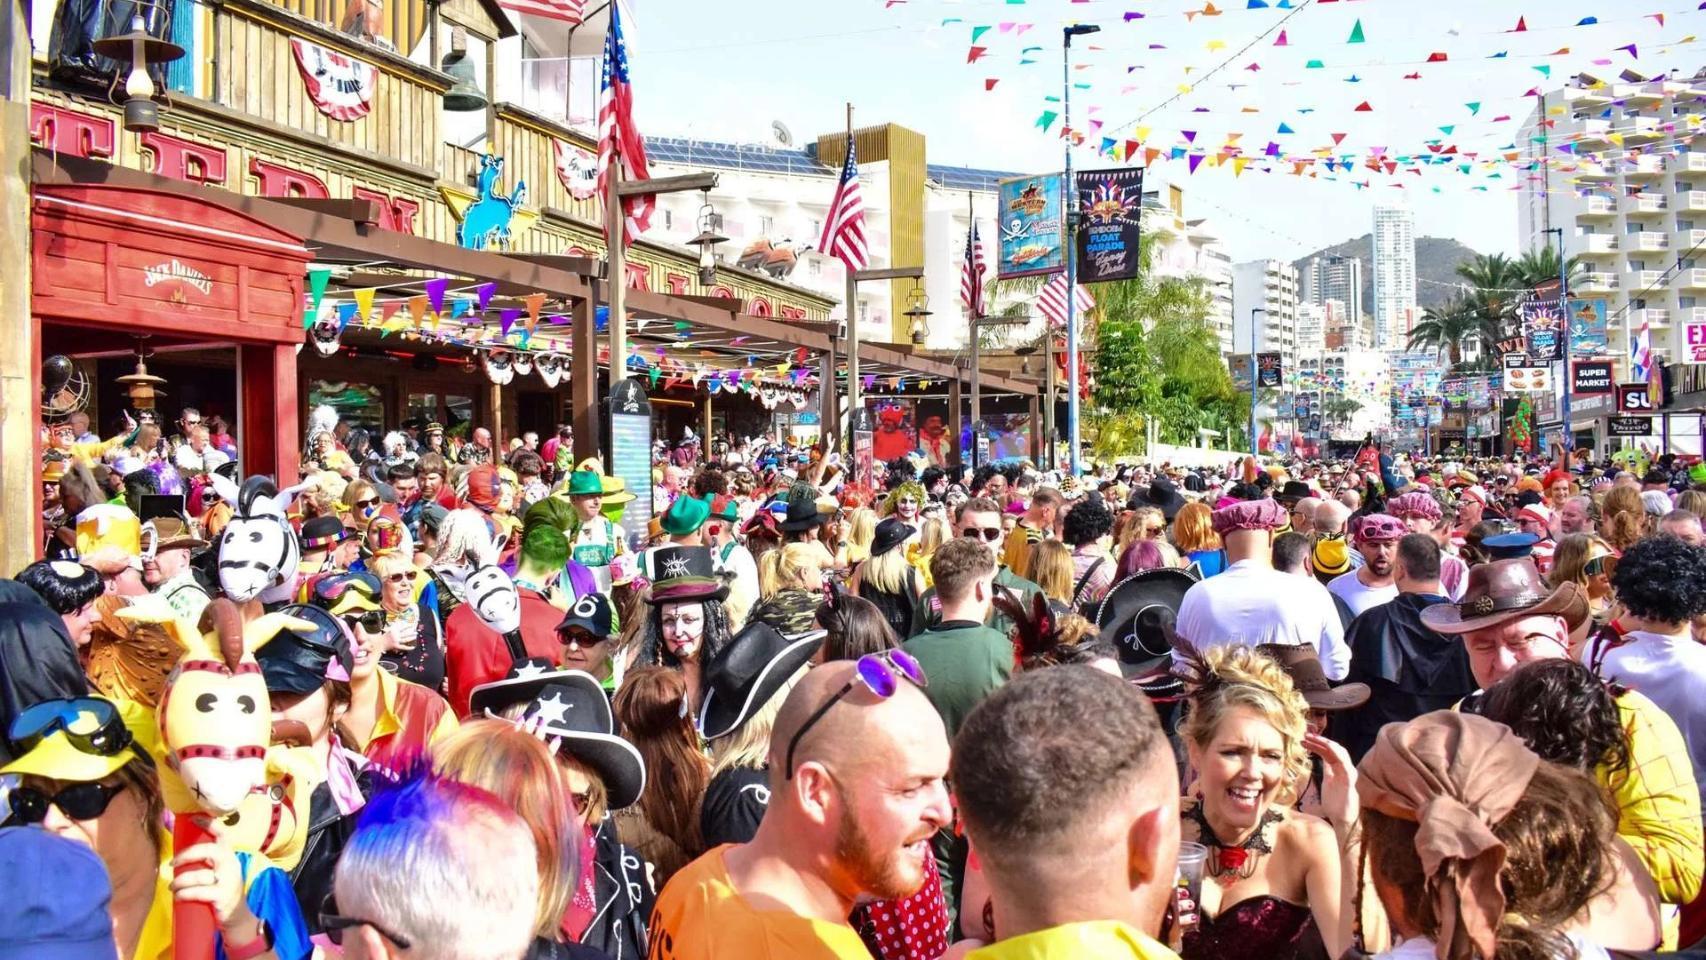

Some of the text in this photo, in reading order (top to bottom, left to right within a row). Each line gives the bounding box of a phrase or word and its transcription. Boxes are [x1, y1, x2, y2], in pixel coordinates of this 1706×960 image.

[1091, 233, 1120, 244] FLOAT
[1086, 242, 1125, 253] PARADE
[1579, 369, 1606, 377] SUPER
[1576, 379, 1610, 387] MARKET
